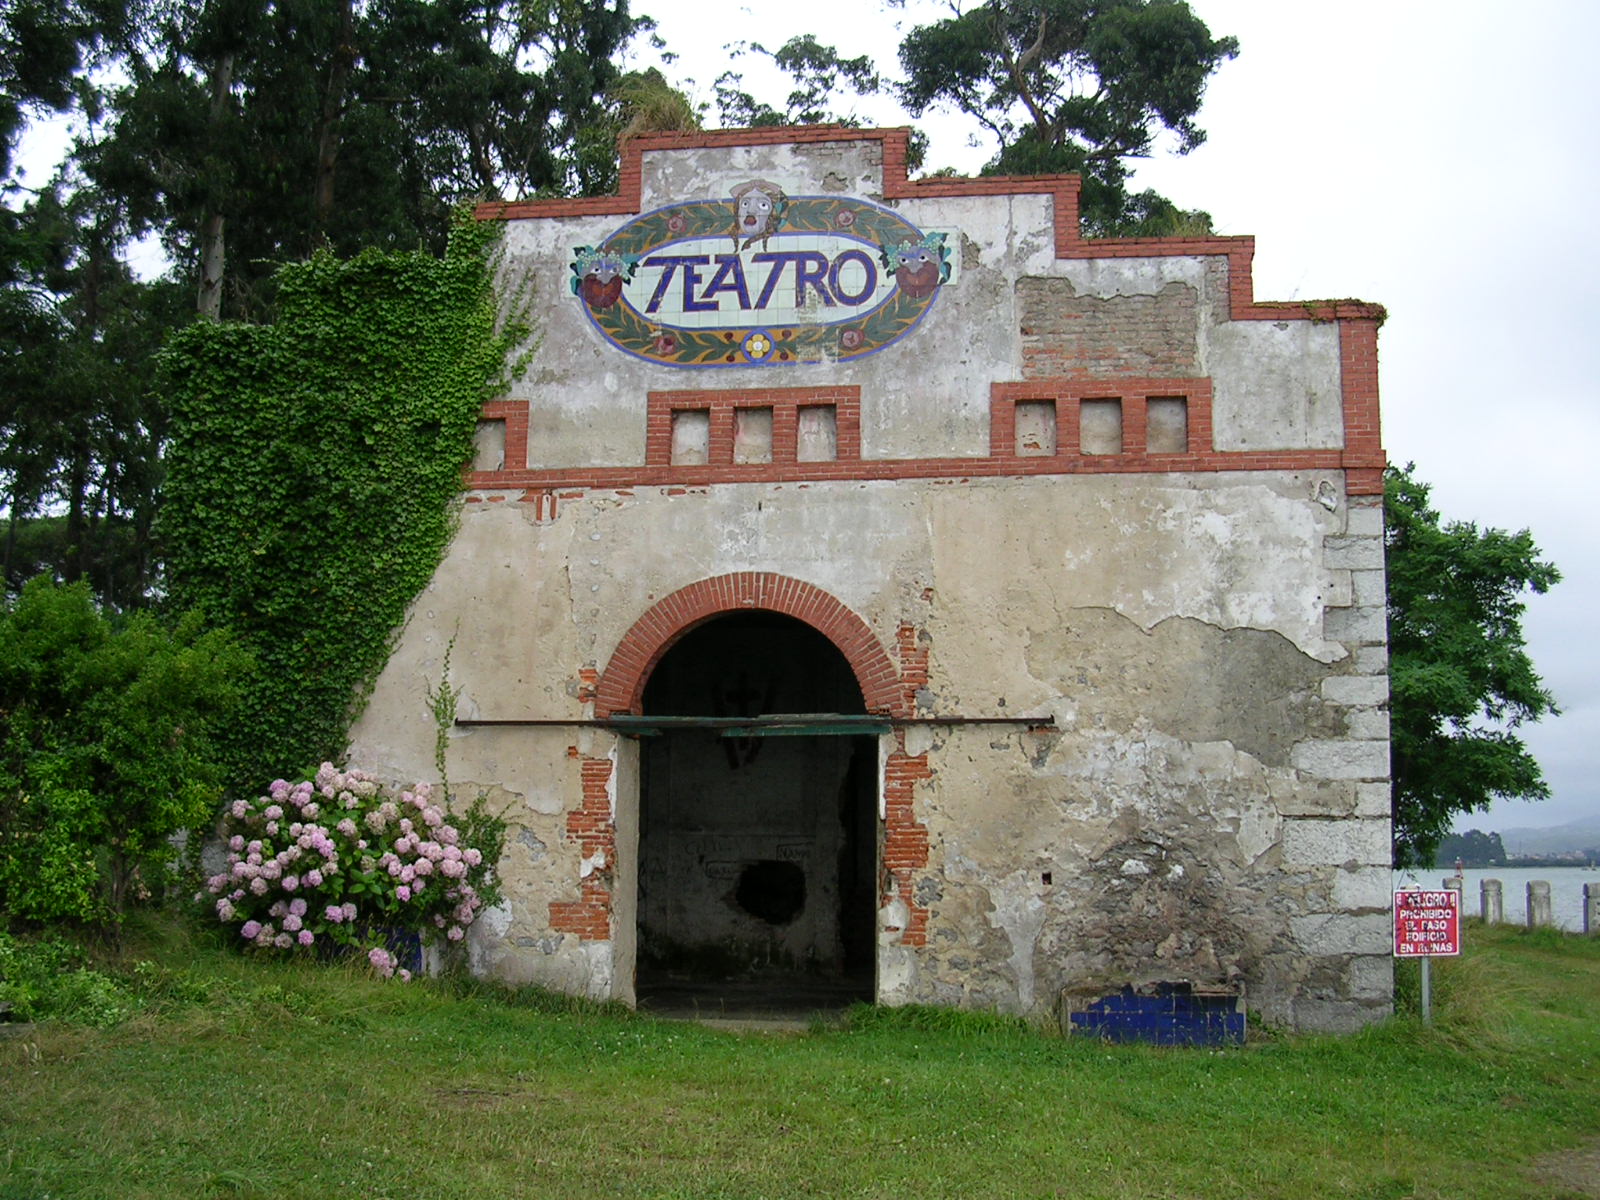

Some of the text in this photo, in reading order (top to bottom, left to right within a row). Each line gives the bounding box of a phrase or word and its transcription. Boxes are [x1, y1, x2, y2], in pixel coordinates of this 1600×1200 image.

[642, 249, 878, 314] TEATRO
[1405, 893, 1448, 908] ELIGRO
[1400, 909, 1452, 919] PROHIBIDO
[1405, 921, 1447, 930] EL PASO
[1406, 932, 1447, 942] EDIFICIO
[1400, 943, 1414, 953] EN
